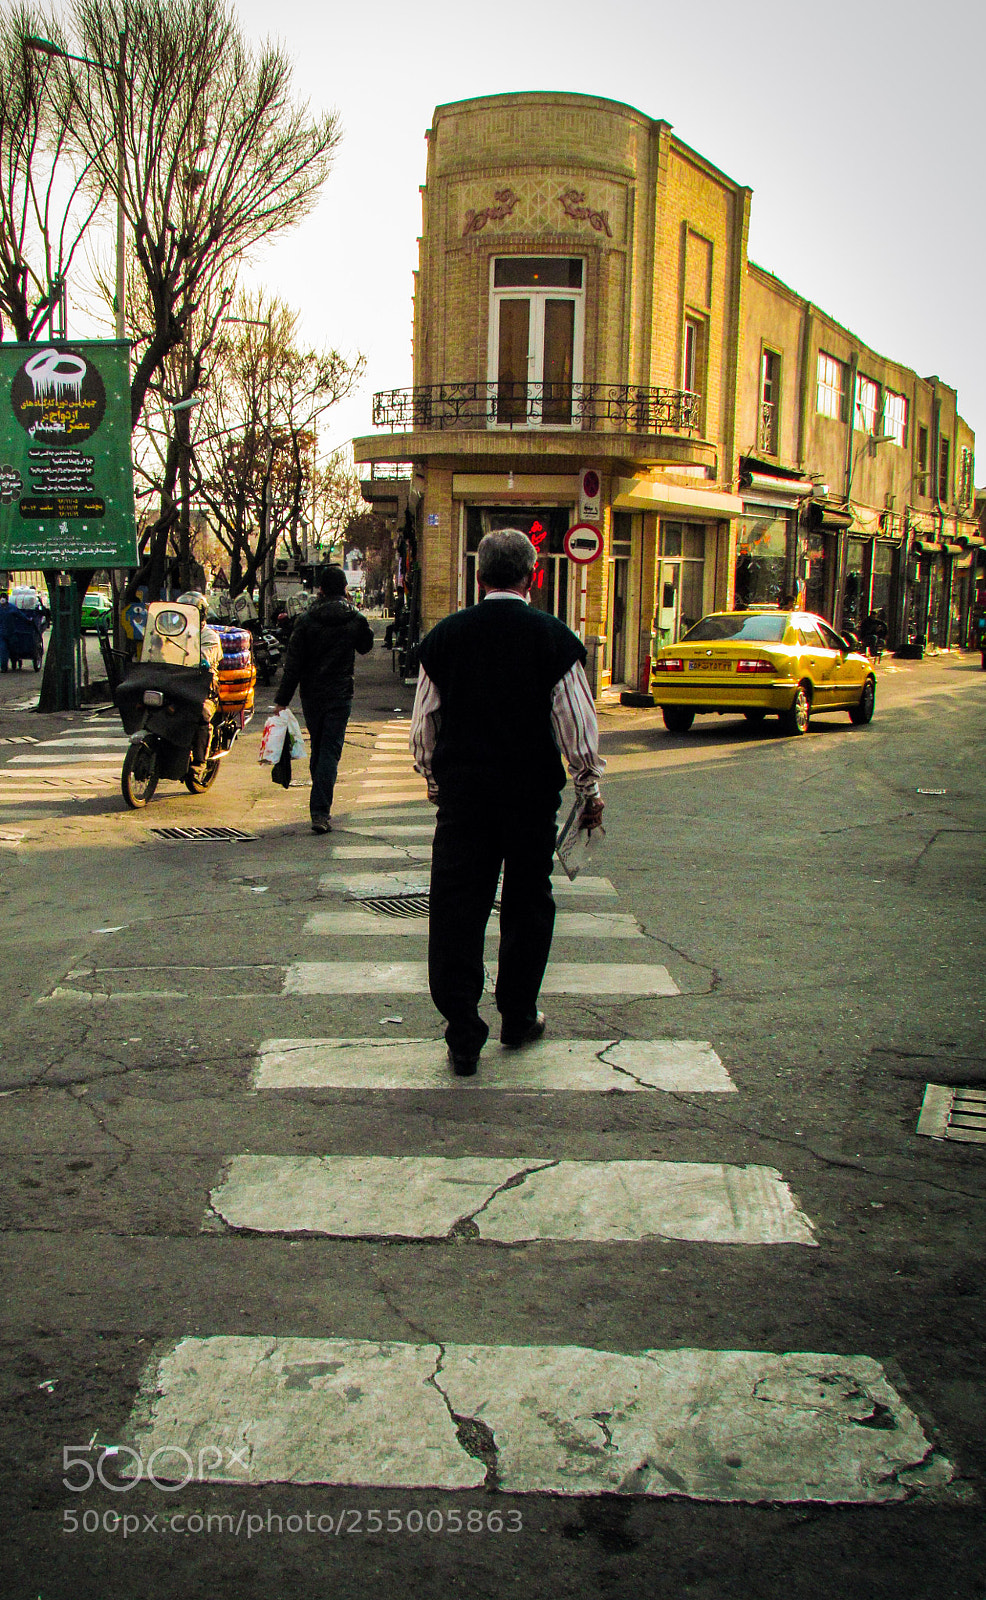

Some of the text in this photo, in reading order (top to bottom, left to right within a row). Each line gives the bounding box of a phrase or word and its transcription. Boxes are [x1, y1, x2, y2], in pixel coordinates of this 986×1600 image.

[40, 410, 78, 423] ازدواج در
[28, 420, 90, 435] عصر یخبندان
